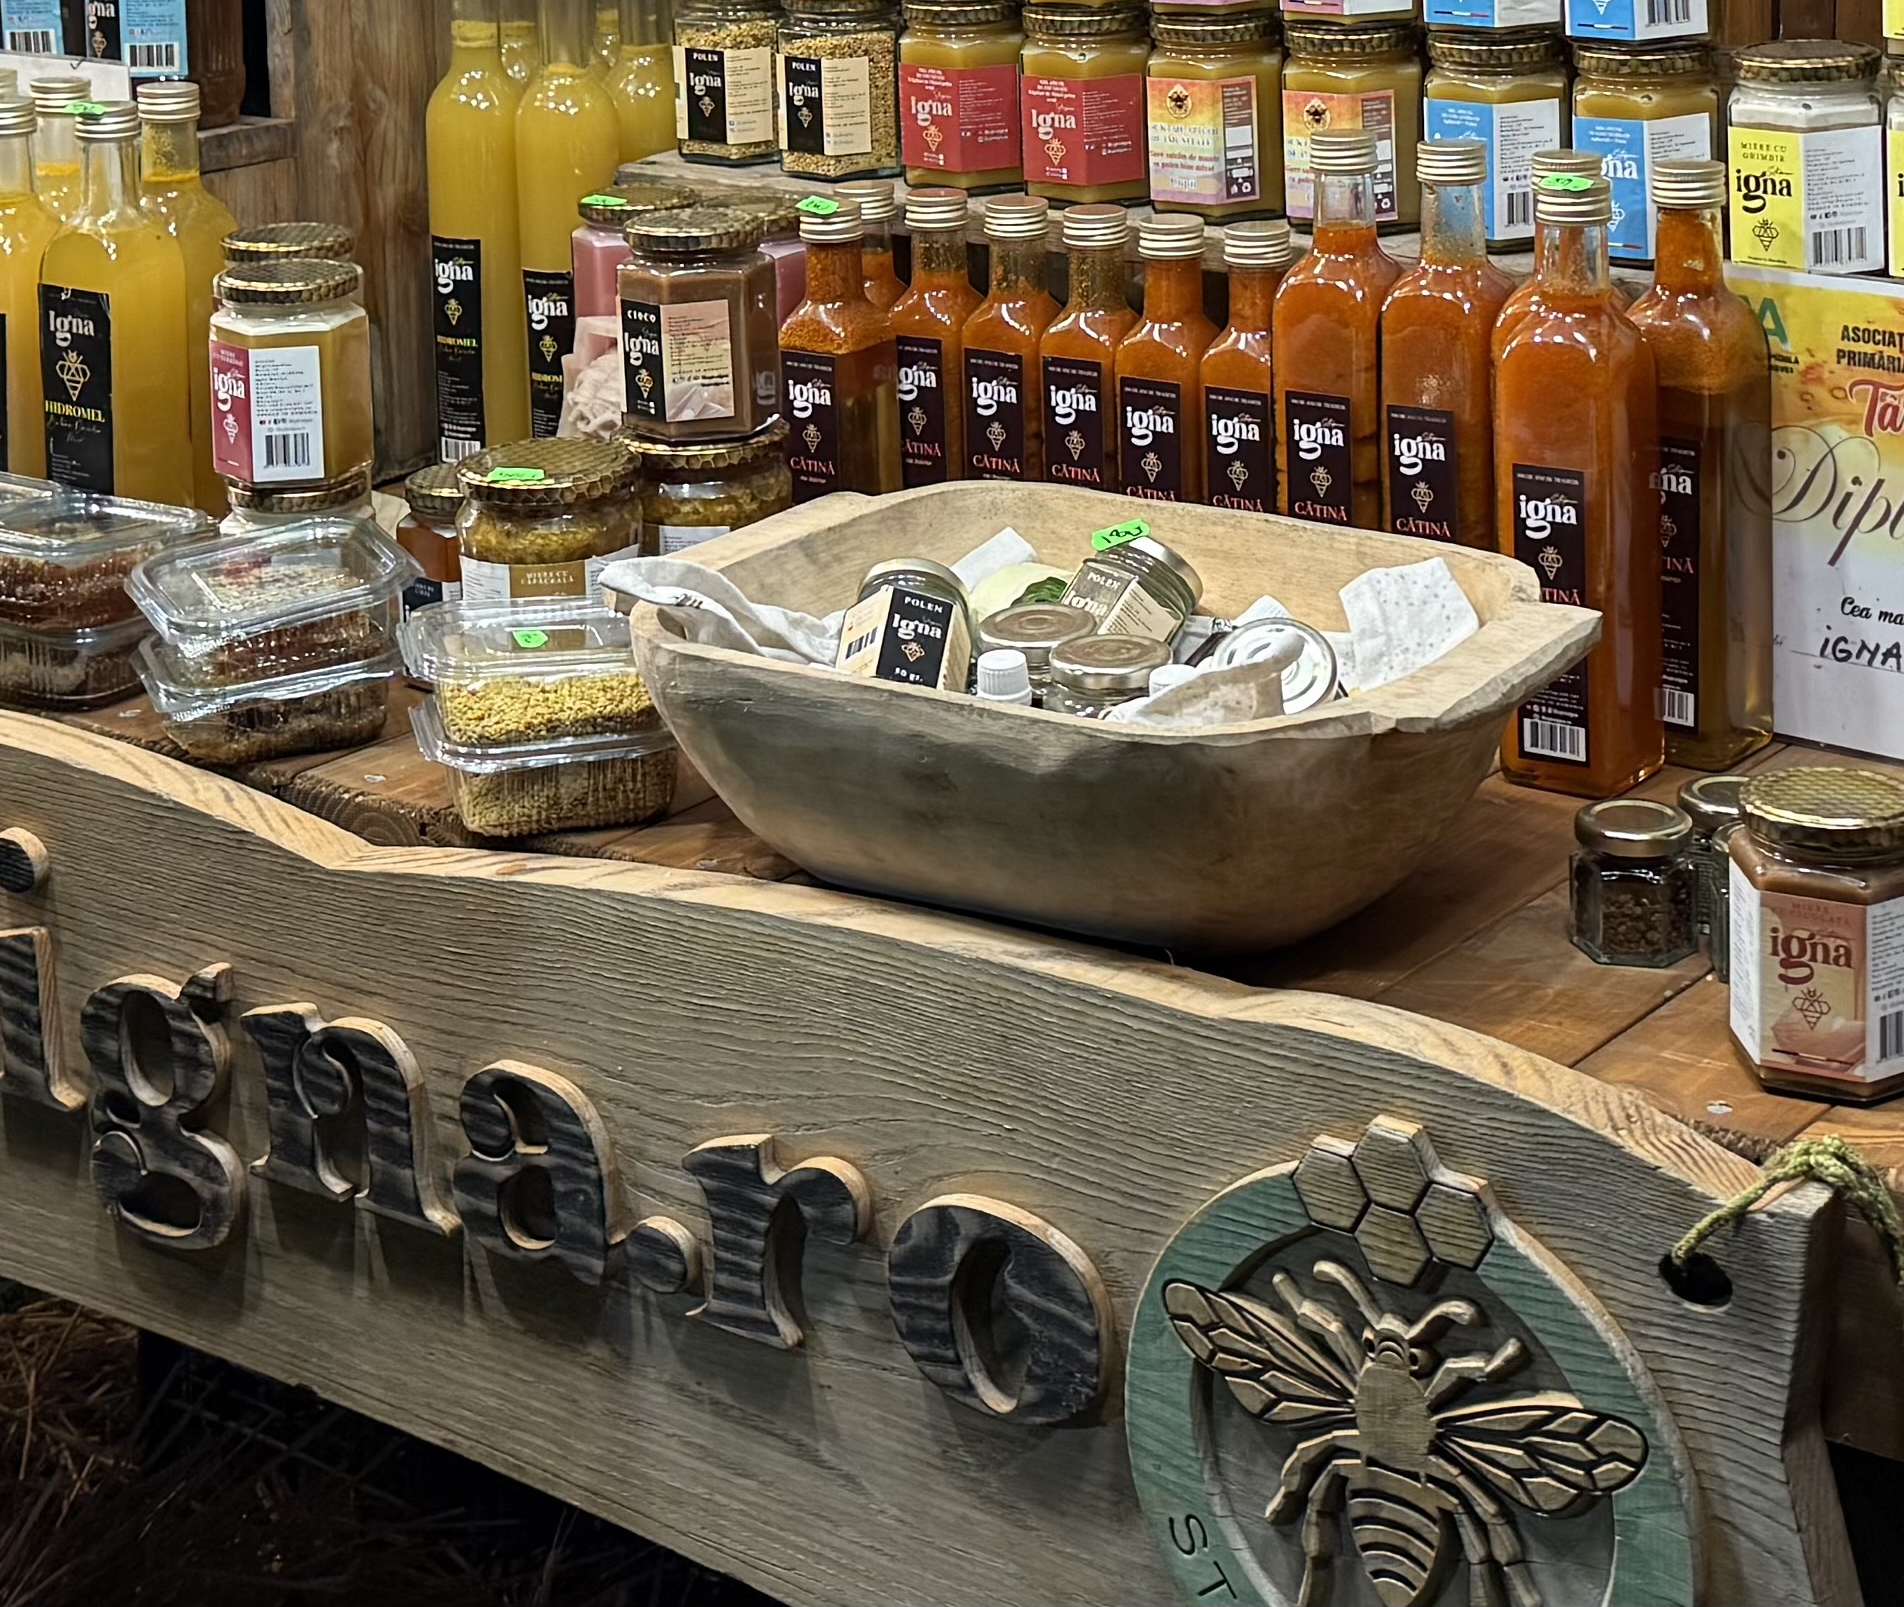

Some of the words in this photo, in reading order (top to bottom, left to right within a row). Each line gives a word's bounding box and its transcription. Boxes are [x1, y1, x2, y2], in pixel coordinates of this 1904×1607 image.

[693, 53, 718, 61] POLEN
[792, 62, 816, 71] POLEN
[1736, 169, 1792, 213] igna
[49, 310, 95, 346] Igna
[214, 368, 245, 411] igna
[788, 380, 831, 418] igna
[899, 365, 937, 400] gna
[972, 378, 1017, 416] igna
[45, 400, 105, 423] HIDROMEL
[1050, 385, 1097, 425] igna
[1126, 407, 1174, 446] igna
[1211, 414, 1260, 454] igna
[1293, 419, 1344, 460] igna
[903, 440, 941, 457] ĂTINĂ
[973, 455, 1020, 473] CĂTINĂ
[1394, 434, 1445, 475] igna
[1052, 464, 1100, 483] CĂTINĂ
[1295, 501, 1347, 521] CĂTINĂ
[1397, 517, 1451, 538] CĂTINĂ
[1520, 494, 1577, 539] igna
[1087, 572, 1120, 590] POLEN
[1543, 588, 1581, 605] TINĂ
[904, 596, 943, 613] POLEN
[1841, 597, 1872, 620] Cea
[1769, 927, 1852, 985] igna
